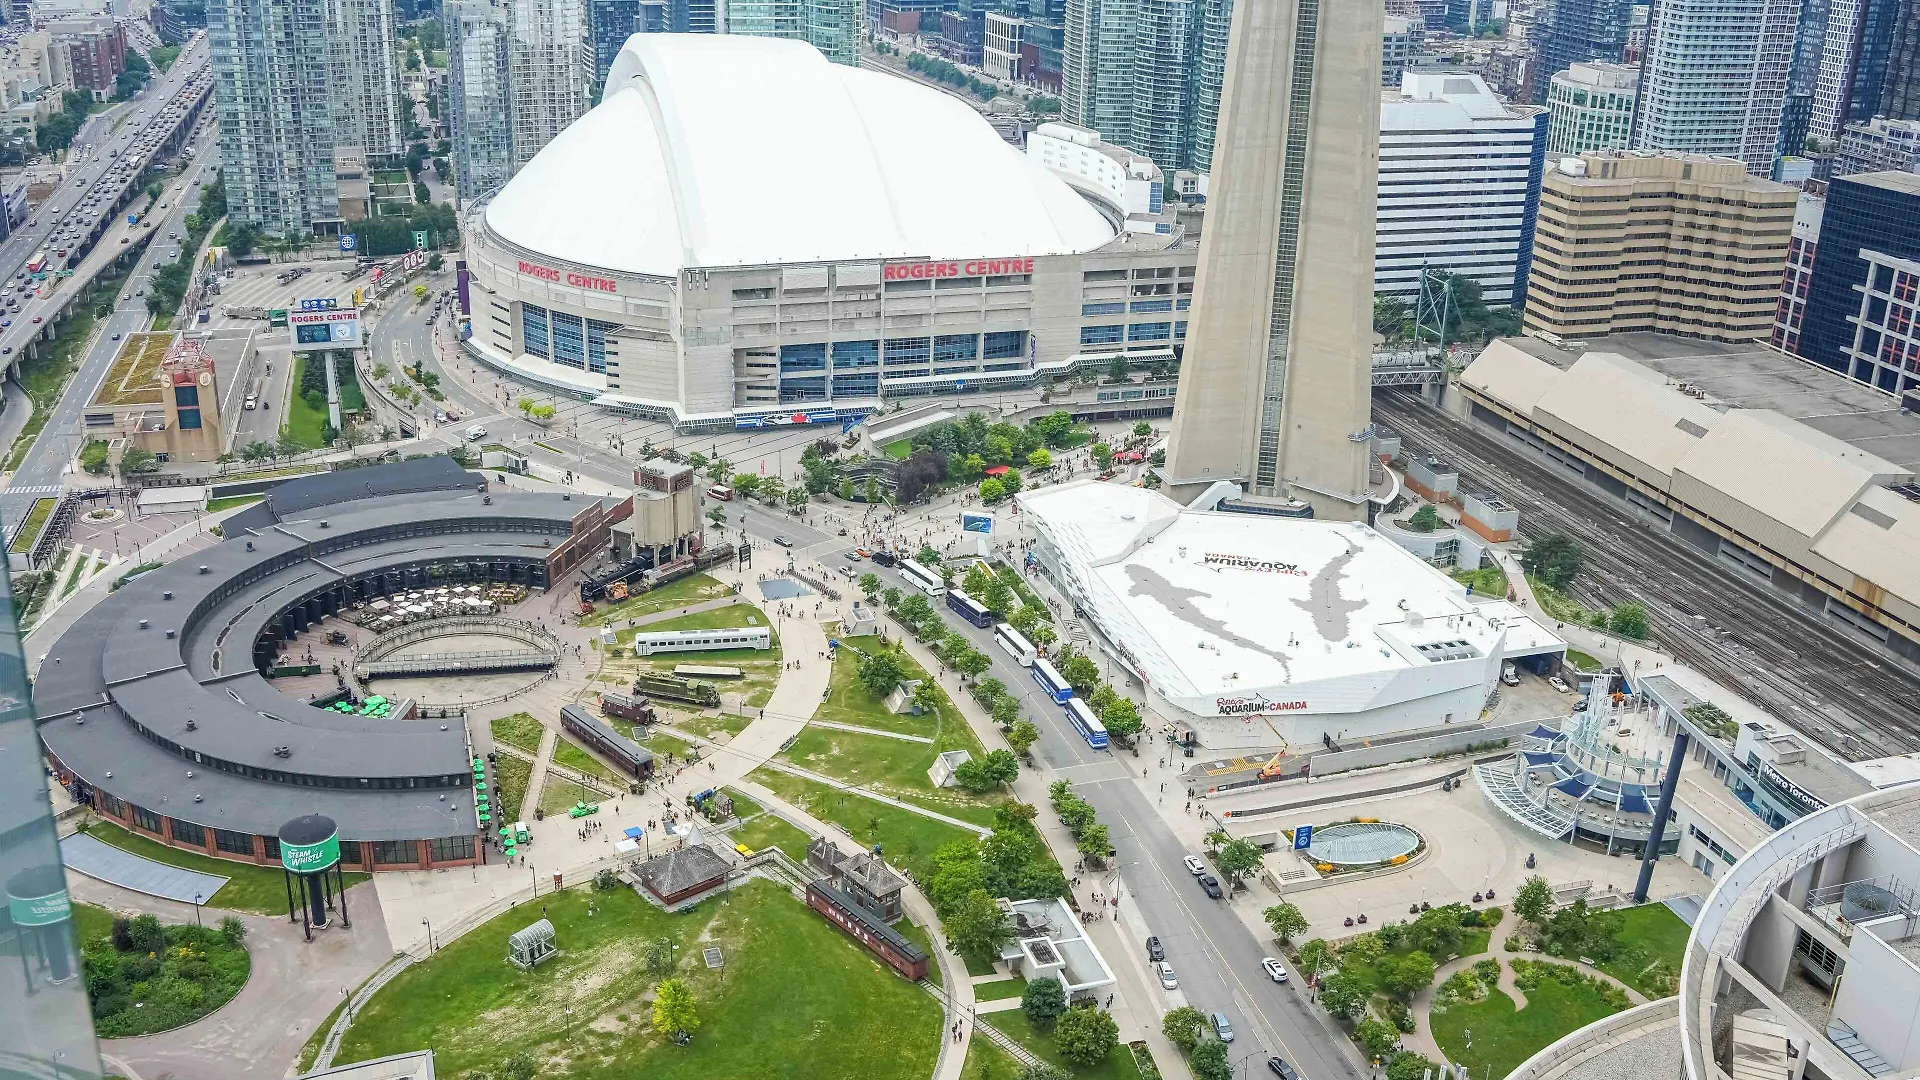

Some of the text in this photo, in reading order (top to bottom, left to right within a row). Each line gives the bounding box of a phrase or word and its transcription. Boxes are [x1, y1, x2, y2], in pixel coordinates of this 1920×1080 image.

[517, 260, 617, 293] ROGERS CENTRE
[884, 258, 1034, 280] ROGERS CENTRE
[291, 313, 358, 323] ROGERS CENTRE
[1204, 556, 1298, 571] AQUARIUM
[1218, 702, 1265, 715] AQUARIUM
[1269, 701, 1308, 711] CANADA
[1764, 764, 1825, 810] Metro Toronto
[287, 850, 311, 859] STEAM
[291, 850, 323, 867] WHISTLE
